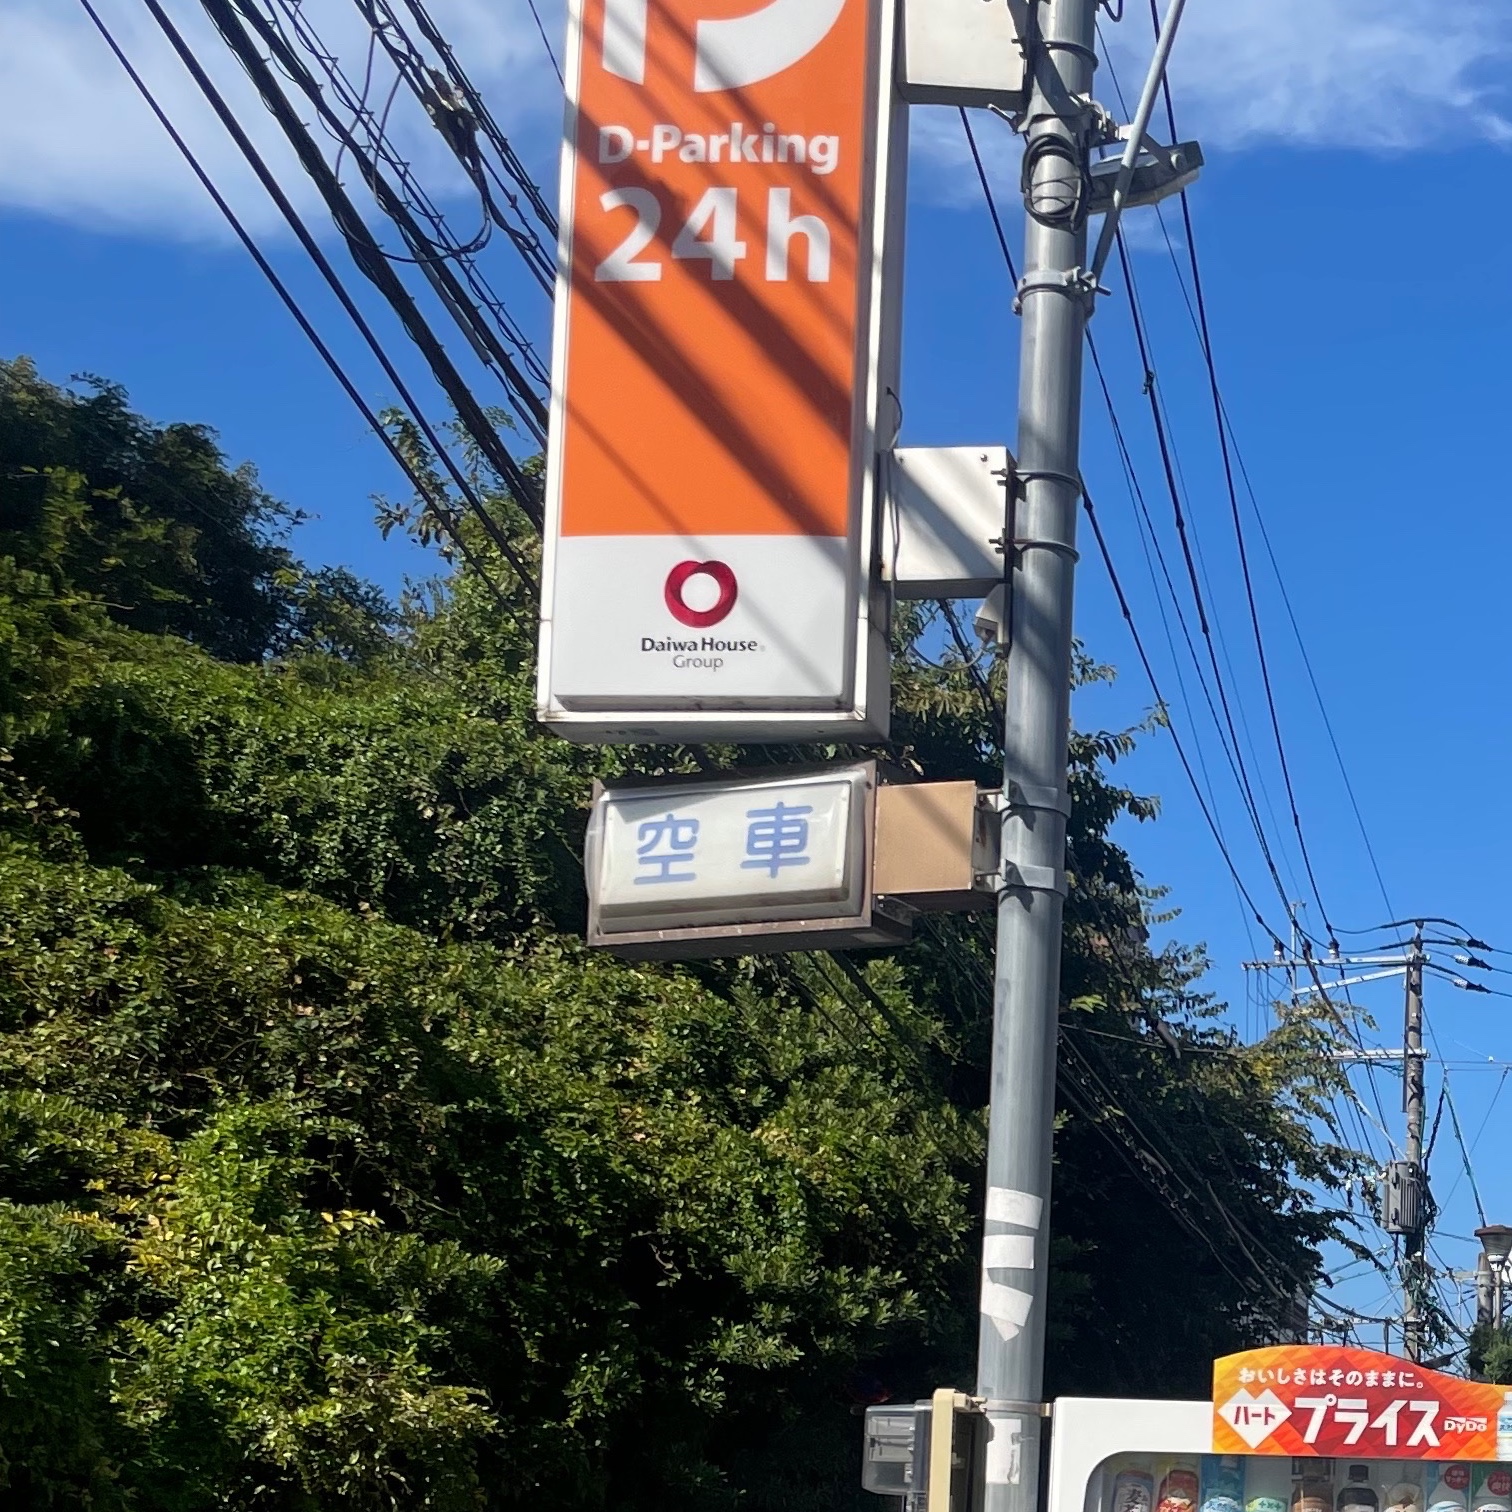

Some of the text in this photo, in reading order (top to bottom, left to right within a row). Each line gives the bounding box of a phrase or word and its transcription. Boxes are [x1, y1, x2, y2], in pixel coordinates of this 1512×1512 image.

[600, 122, 839, 174] D-Parking
[595, 186, 832, 282] 24h
[641, 637, 758, 653] Daiwa House
[673, 654, 724, 671] Group
[633, 801, 814, 885] 空車
[1238, 1366, 1425, 1389] おいしさはそのままに。
[1234, 1406, 1277, 1426] ハート
[1294, 1393, 1441, 1447] プライス
[1444, 1417, 1488, 1434] DyDo
